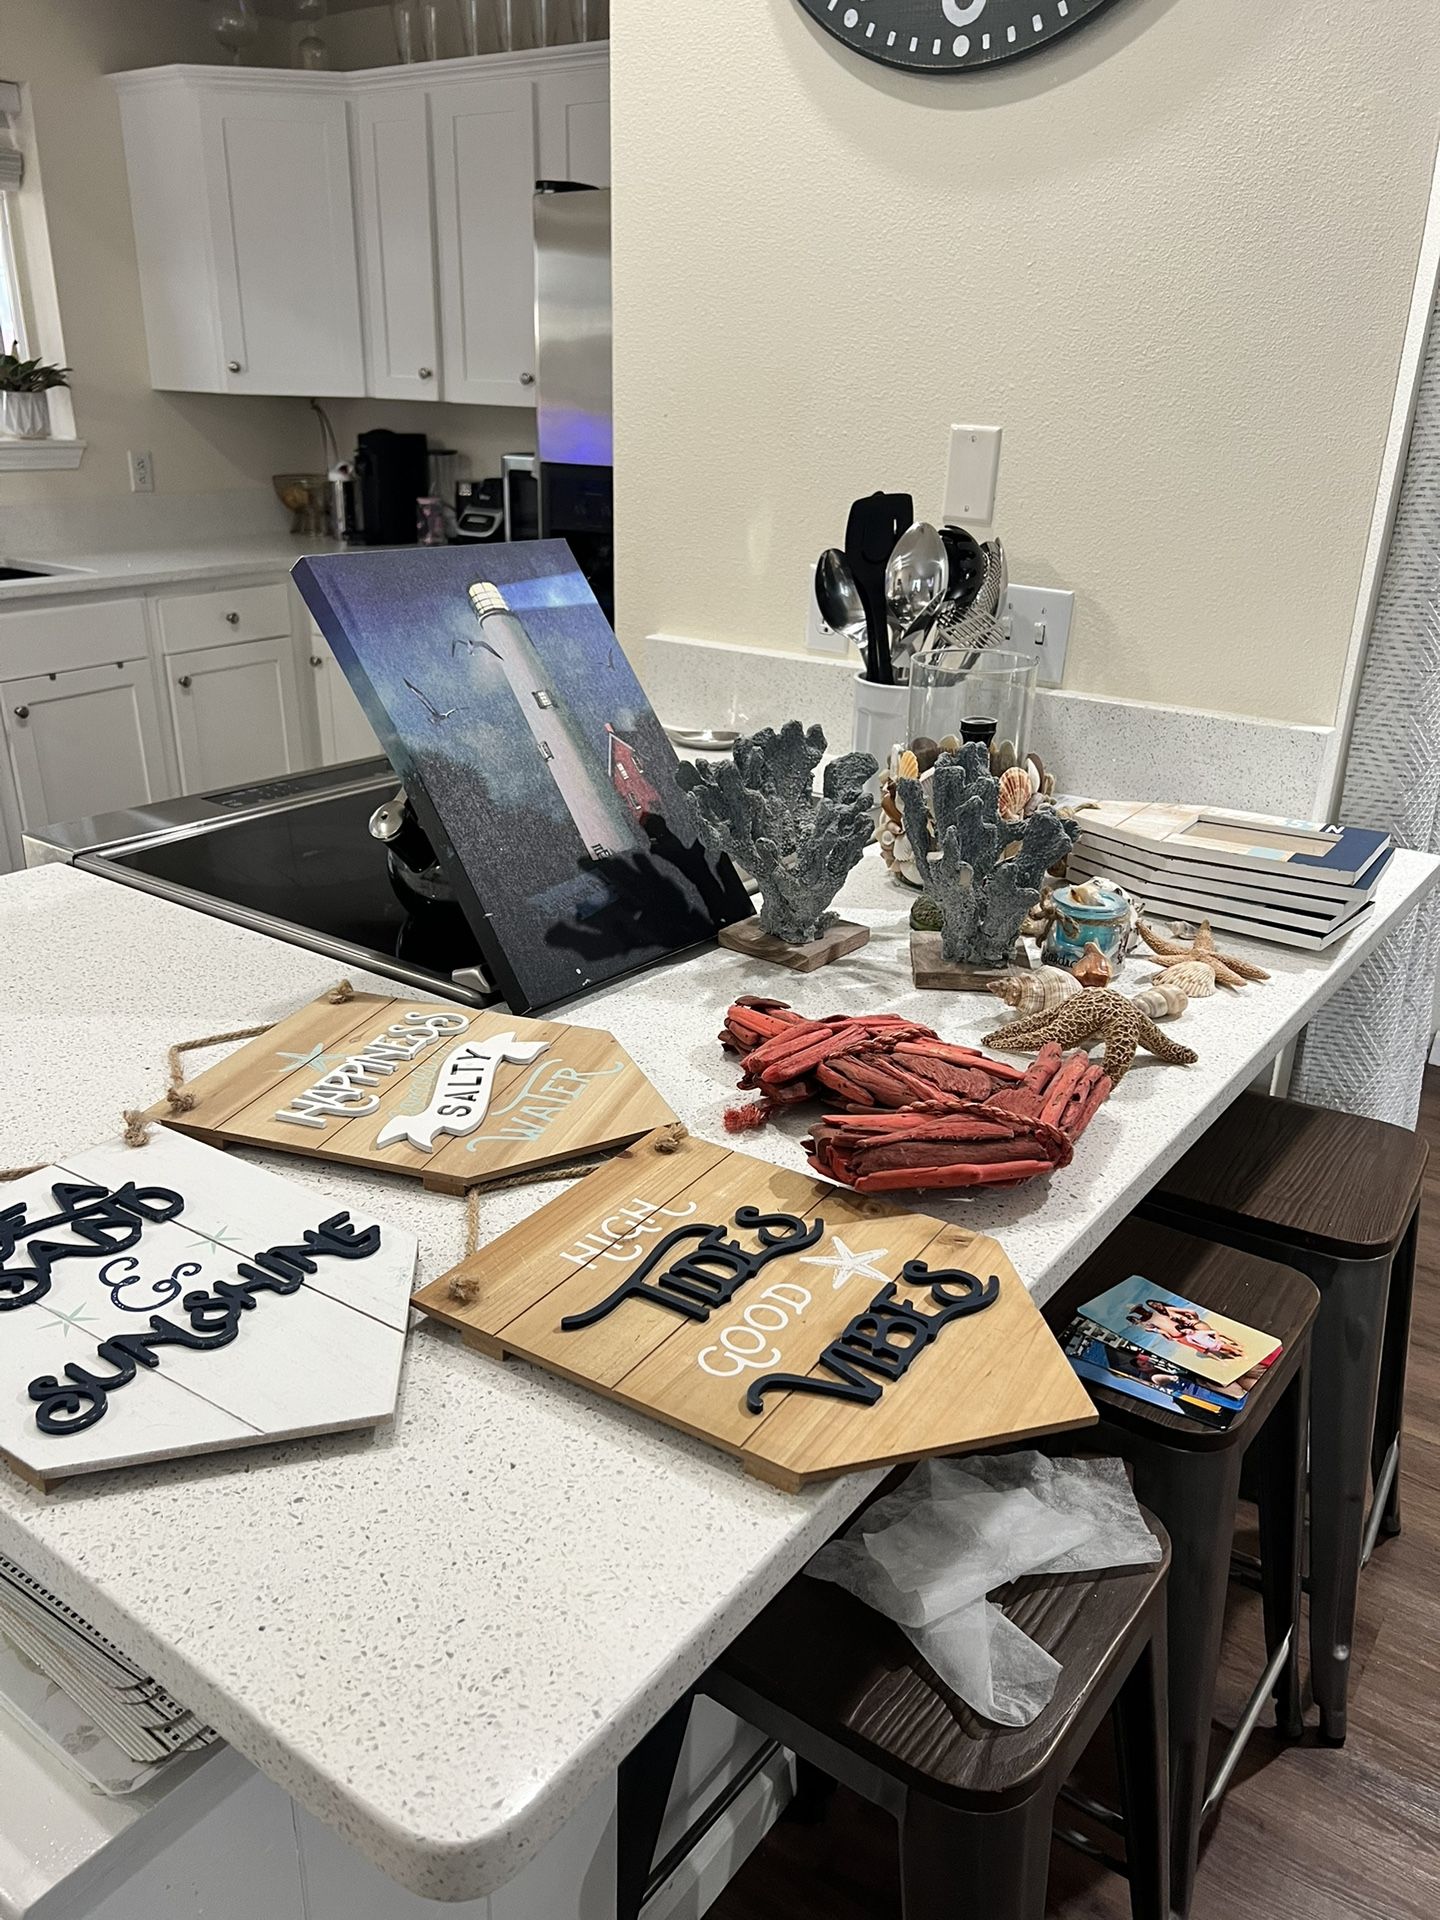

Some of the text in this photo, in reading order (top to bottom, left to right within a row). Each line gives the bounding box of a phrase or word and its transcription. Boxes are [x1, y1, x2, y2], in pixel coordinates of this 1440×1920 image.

[275, 1011, 469, 1129] HAPPINESS
[437, 1048, 492, 1117] SALTY
[466, 1058, 624, 1153] WATER
[559, 1197, 697, 1271] HIGH
[560, 1205, 824, 1331] TIDES
[28, 1211, 381, 1435] SUNSHINE
[99, 1257, 203, 1313] &
[697, 1283, 812, 1378] GOOD
[746, 1259, 1001, 1415] VIBES
